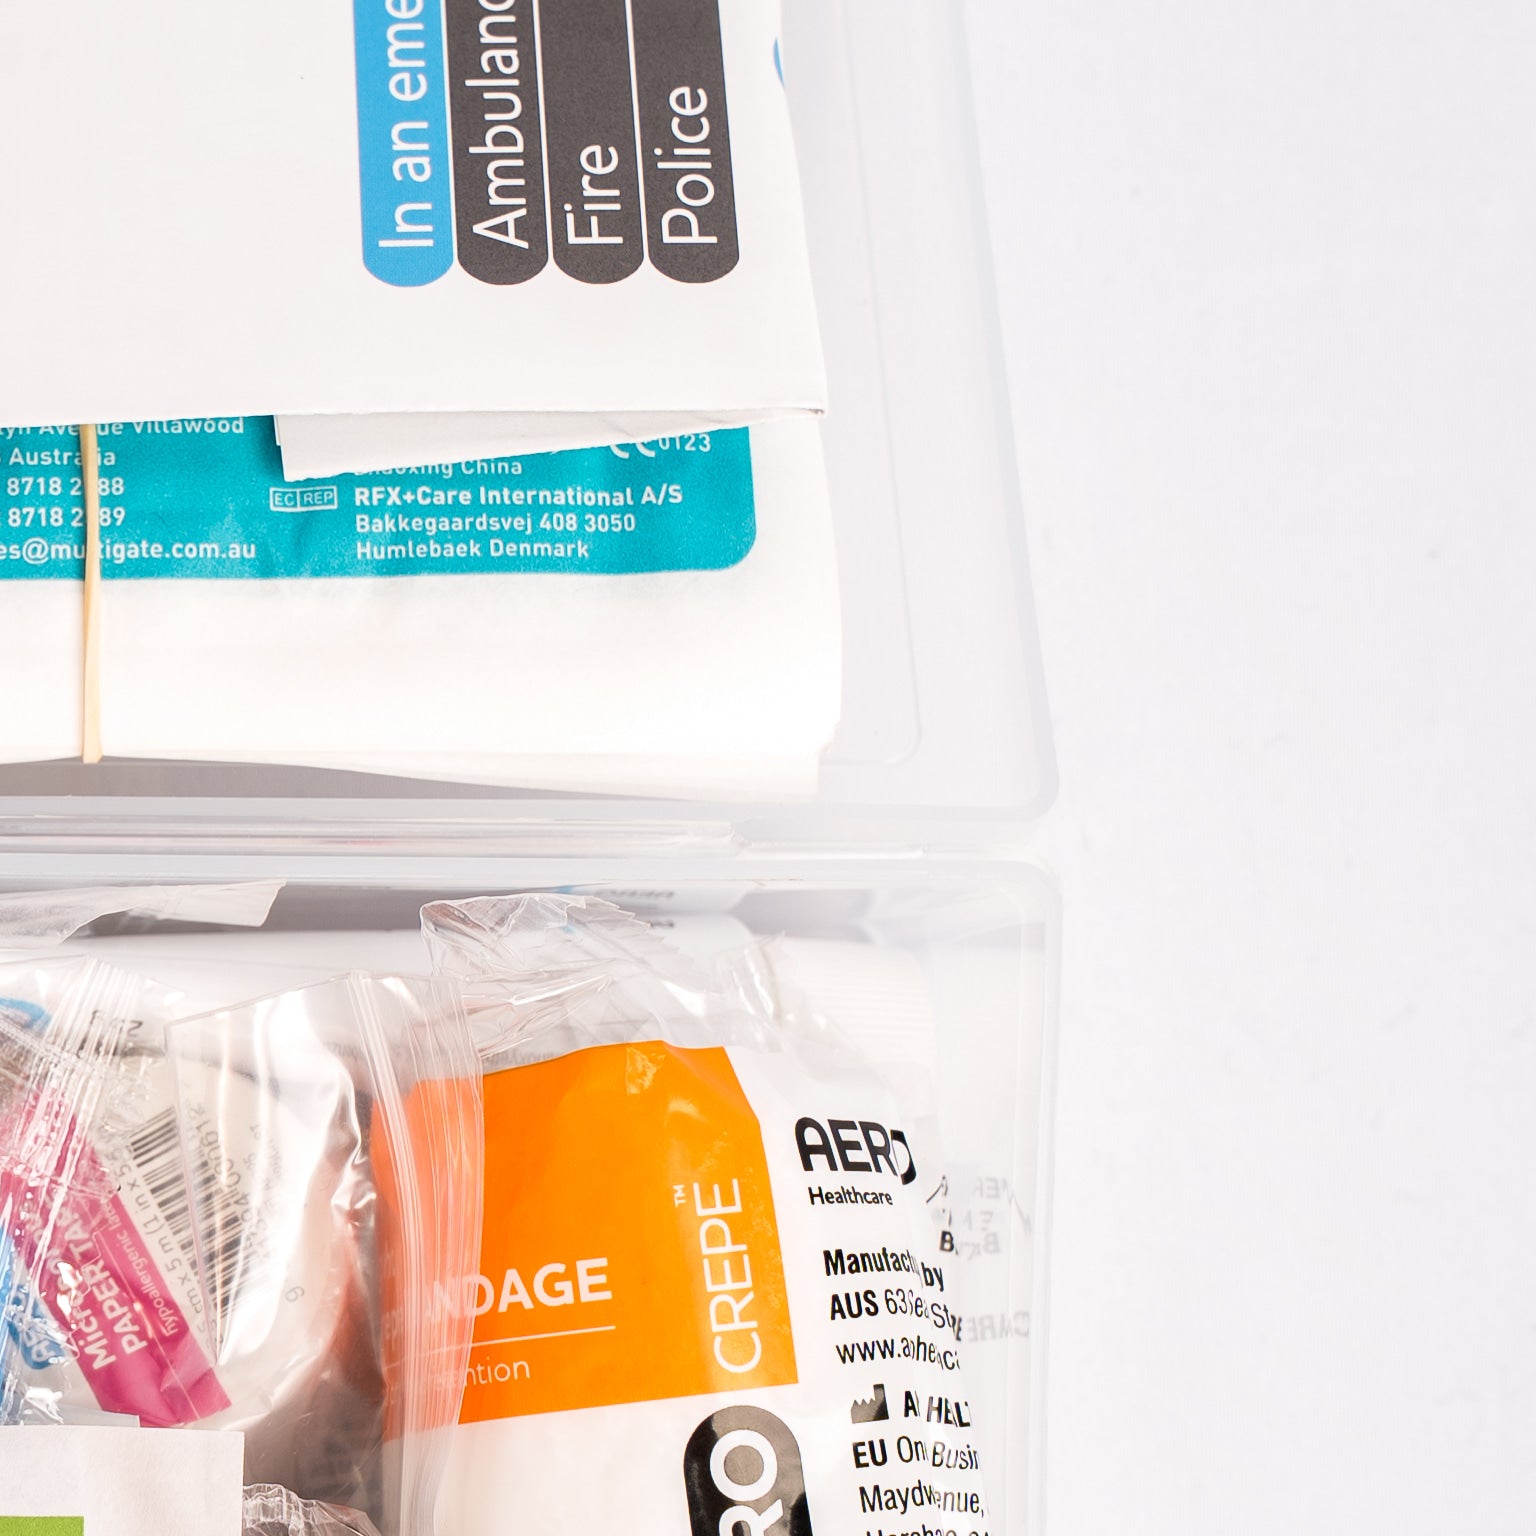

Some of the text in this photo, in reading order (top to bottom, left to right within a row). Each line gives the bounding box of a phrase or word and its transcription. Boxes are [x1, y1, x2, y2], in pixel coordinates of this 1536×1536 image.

[391, 122, 430, 184] an
[655, 84, 718, 245] Police
[566, 143, 623, 246] Fire
[380, 202, 433, 248] In
[9, 446, 115, 466] Austraia
[461, 458, 522, 476] China
[7, 477, 61, 496] 8718
[71, 477, 124, 496] 288
[275, 490, 334, 506] EC REP
[355, 484, 683, 506] RFX+Care International A/S
[356, 512, 635, 535] Bakkegaardsvej 408 3050
[356, 539, 589, 560] Humlebaek Denmark
[809, 1187, 892, 1207] Healthcare
[695, 1178, 762, 1374] CREPE
[830, 1292, 879, 1320] AUS
[852, 1441, 887, 1468] EU
